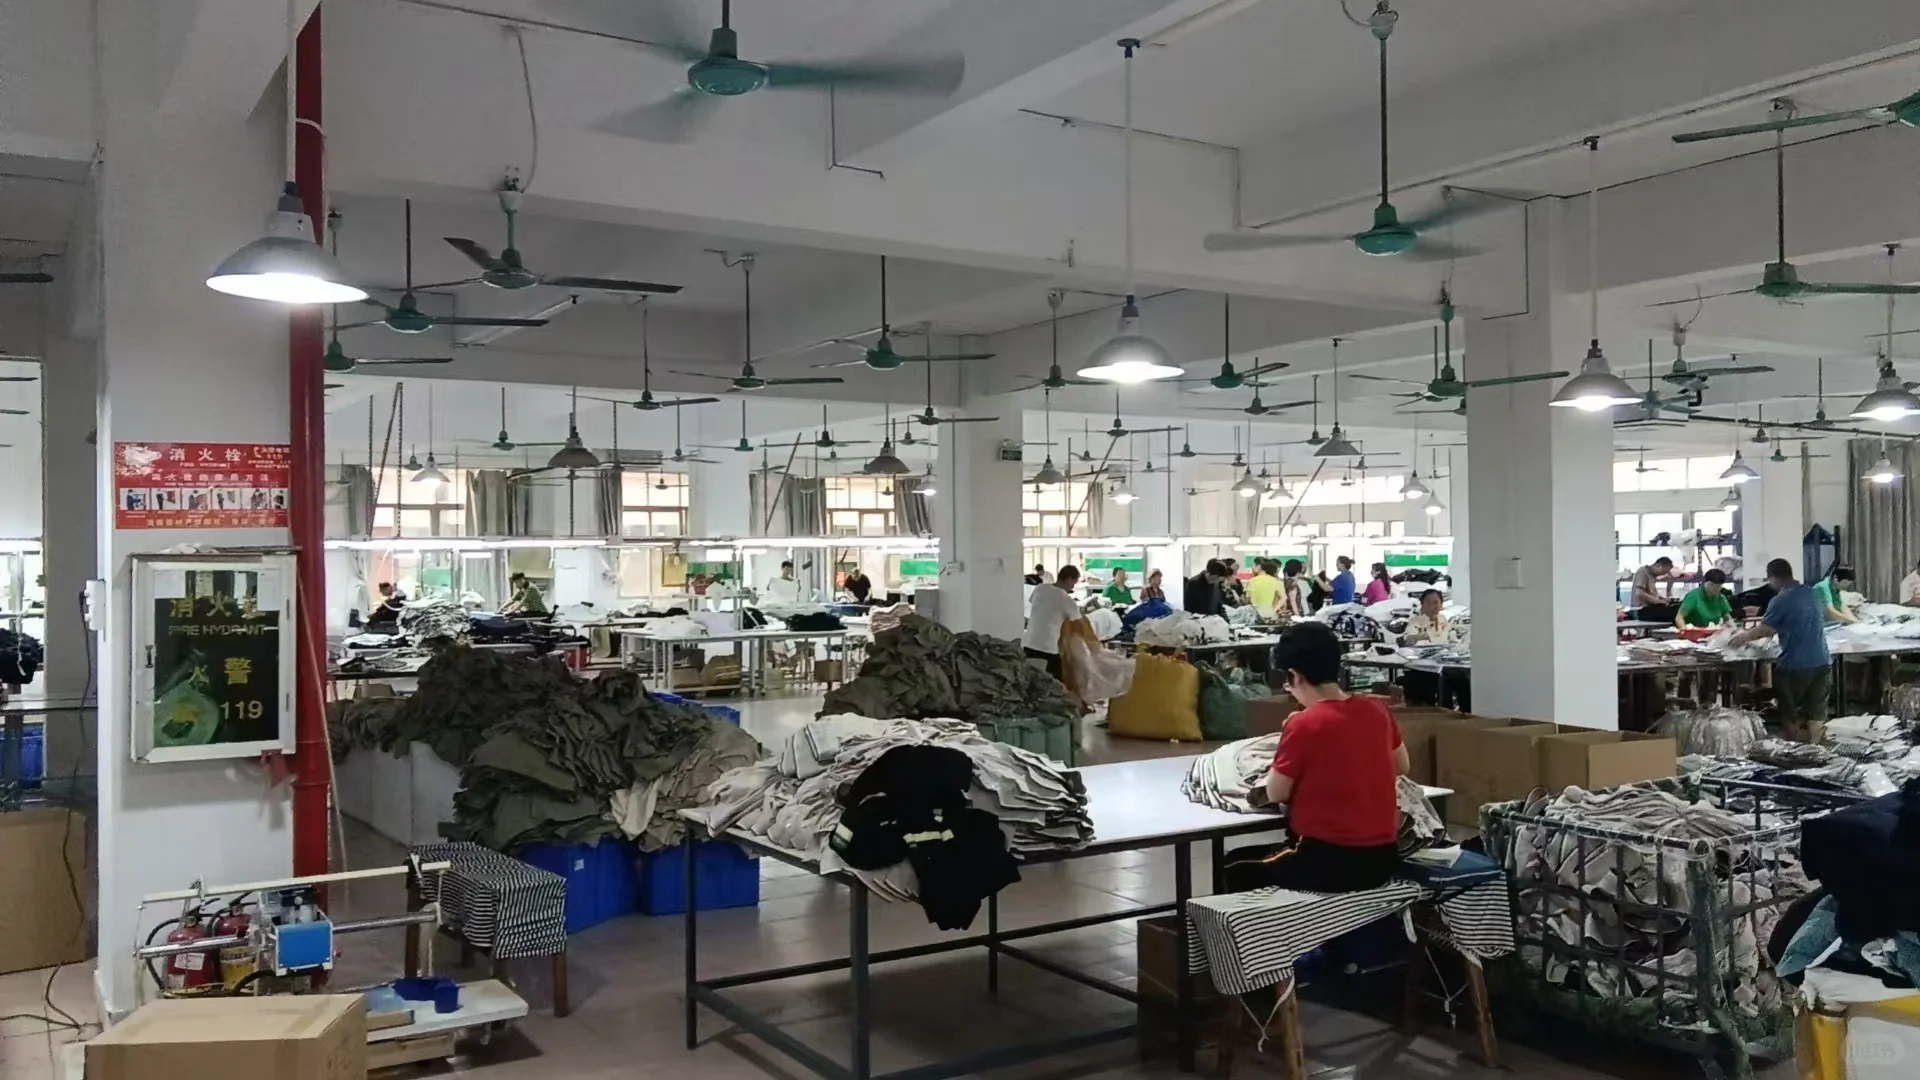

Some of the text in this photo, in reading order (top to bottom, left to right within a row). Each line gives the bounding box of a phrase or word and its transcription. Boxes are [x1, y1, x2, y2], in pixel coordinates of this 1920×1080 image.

[169, 447, 242, 461] 消火栓
[220, 700, 264, 720] 119
